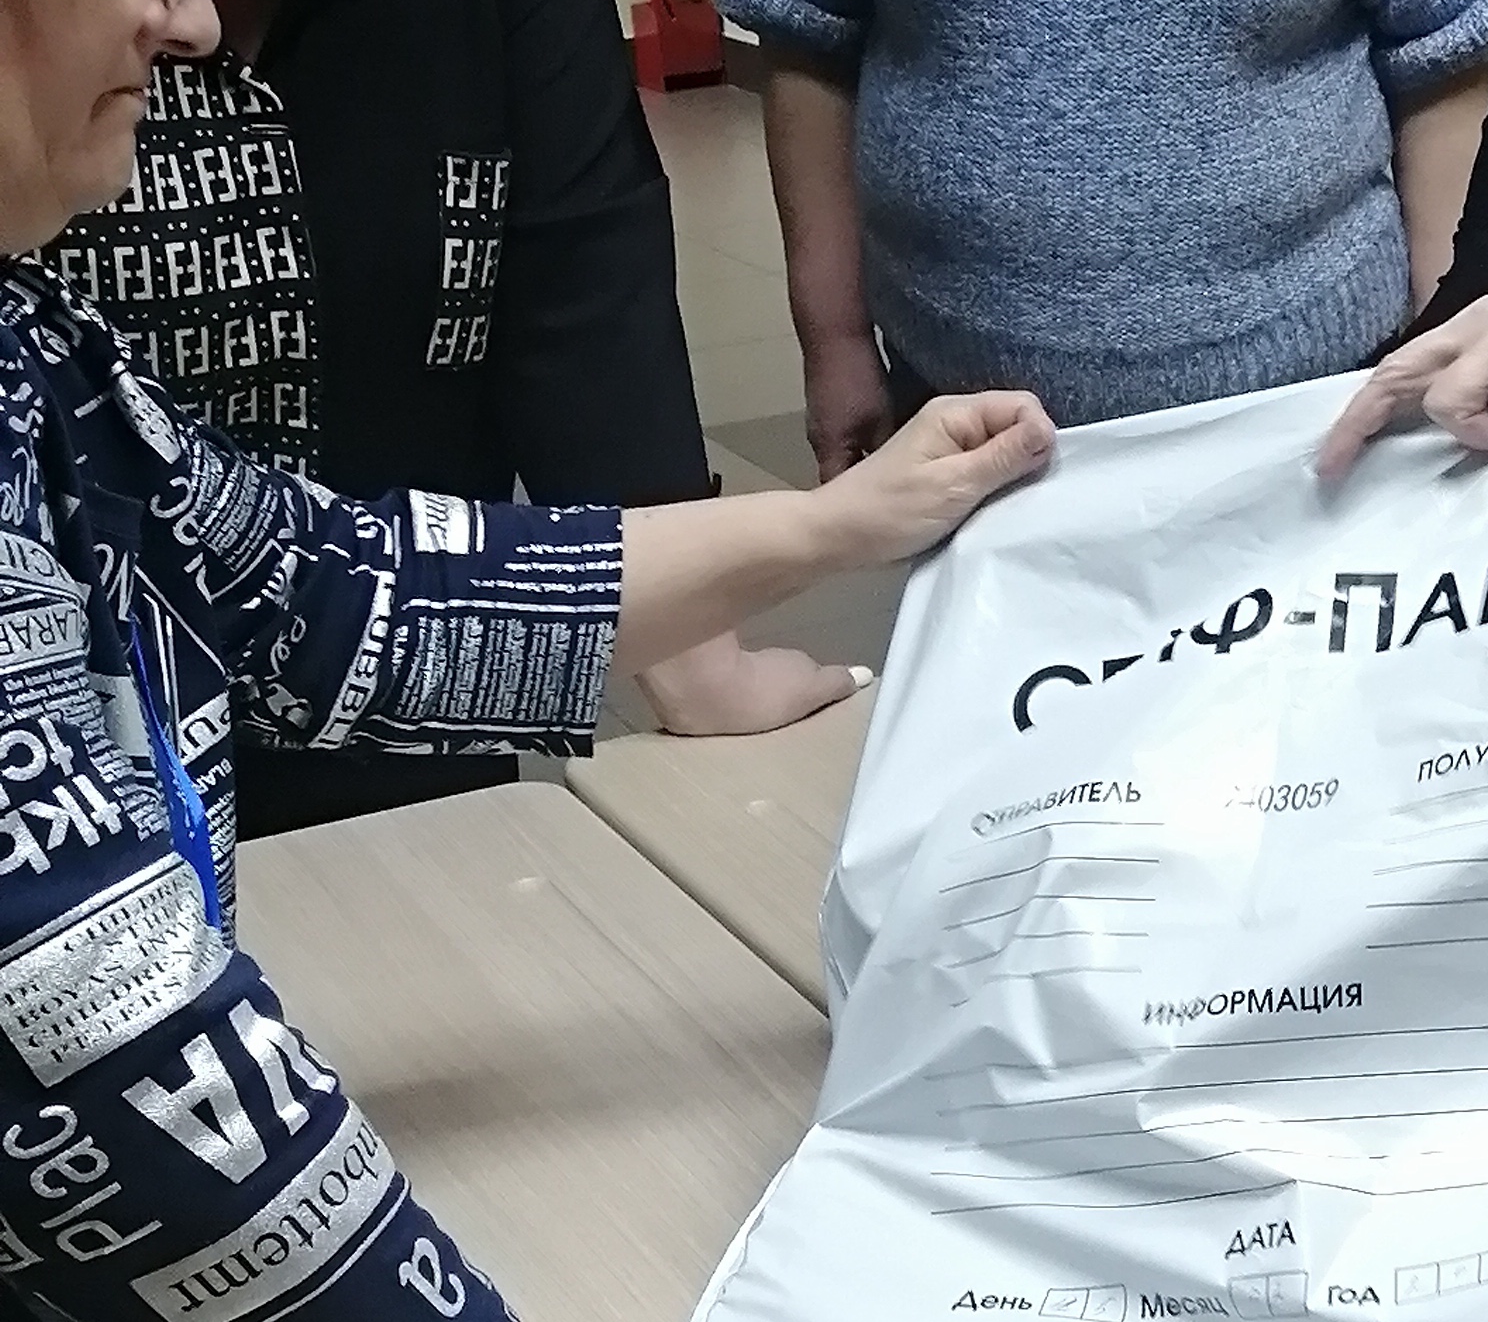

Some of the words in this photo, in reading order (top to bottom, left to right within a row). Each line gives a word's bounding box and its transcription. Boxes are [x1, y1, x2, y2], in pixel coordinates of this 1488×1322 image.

[1225, 1220, 1297, 1260] ДАТА
[951, 1290, 1033, 1312] День
[1139, 1292, 1231, 1320] Месяц
